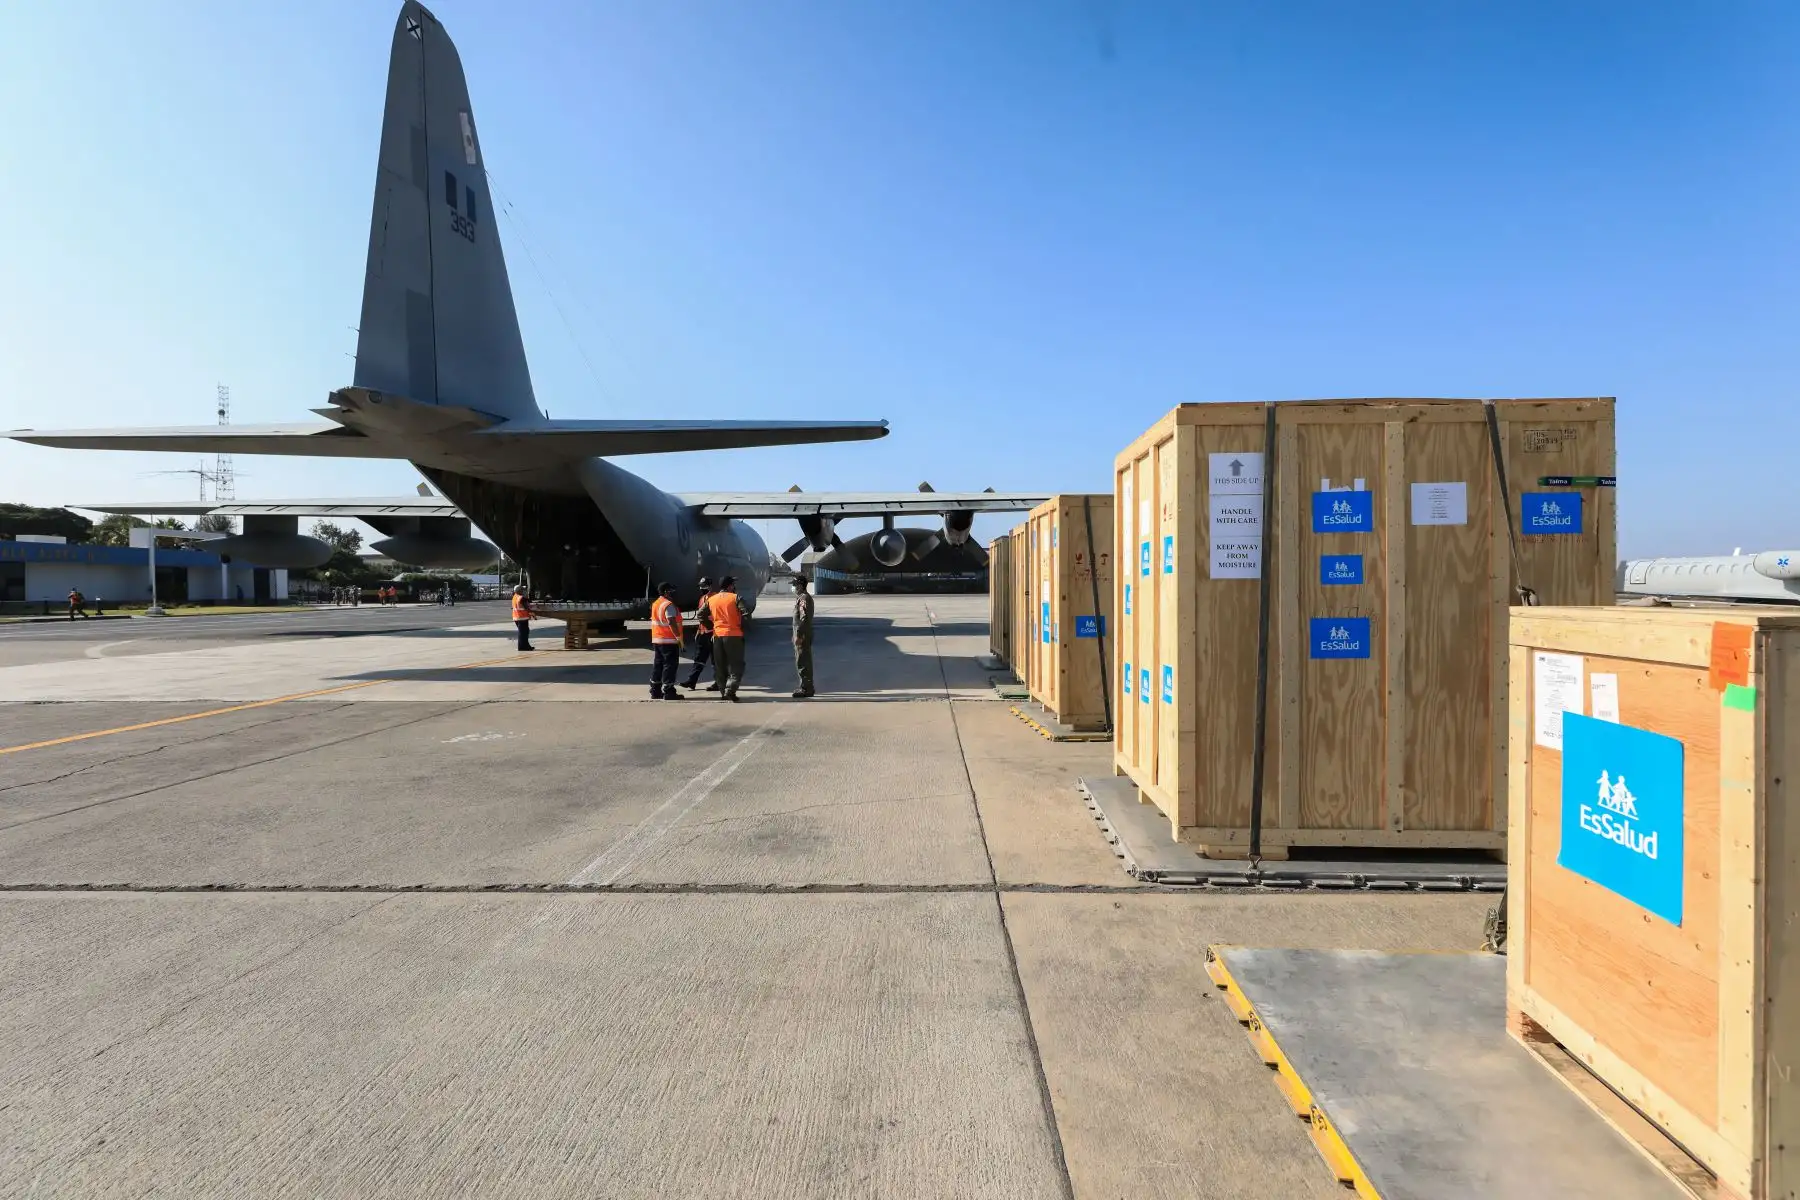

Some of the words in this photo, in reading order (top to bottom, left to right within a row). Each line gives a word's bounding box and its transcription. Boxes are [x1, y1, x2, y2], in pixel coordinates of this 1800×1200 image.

[451, 210, 475, 243] 393
[1323, 513, 1362, 525] EsSalud
[1532, 515, 1571, 526] EsSalud
[1328, 571, 1355, 579] EsSalud
[1320, 640, 1360, 651] EsSalud
[1579, 803, 1658, 860] EsSalud
